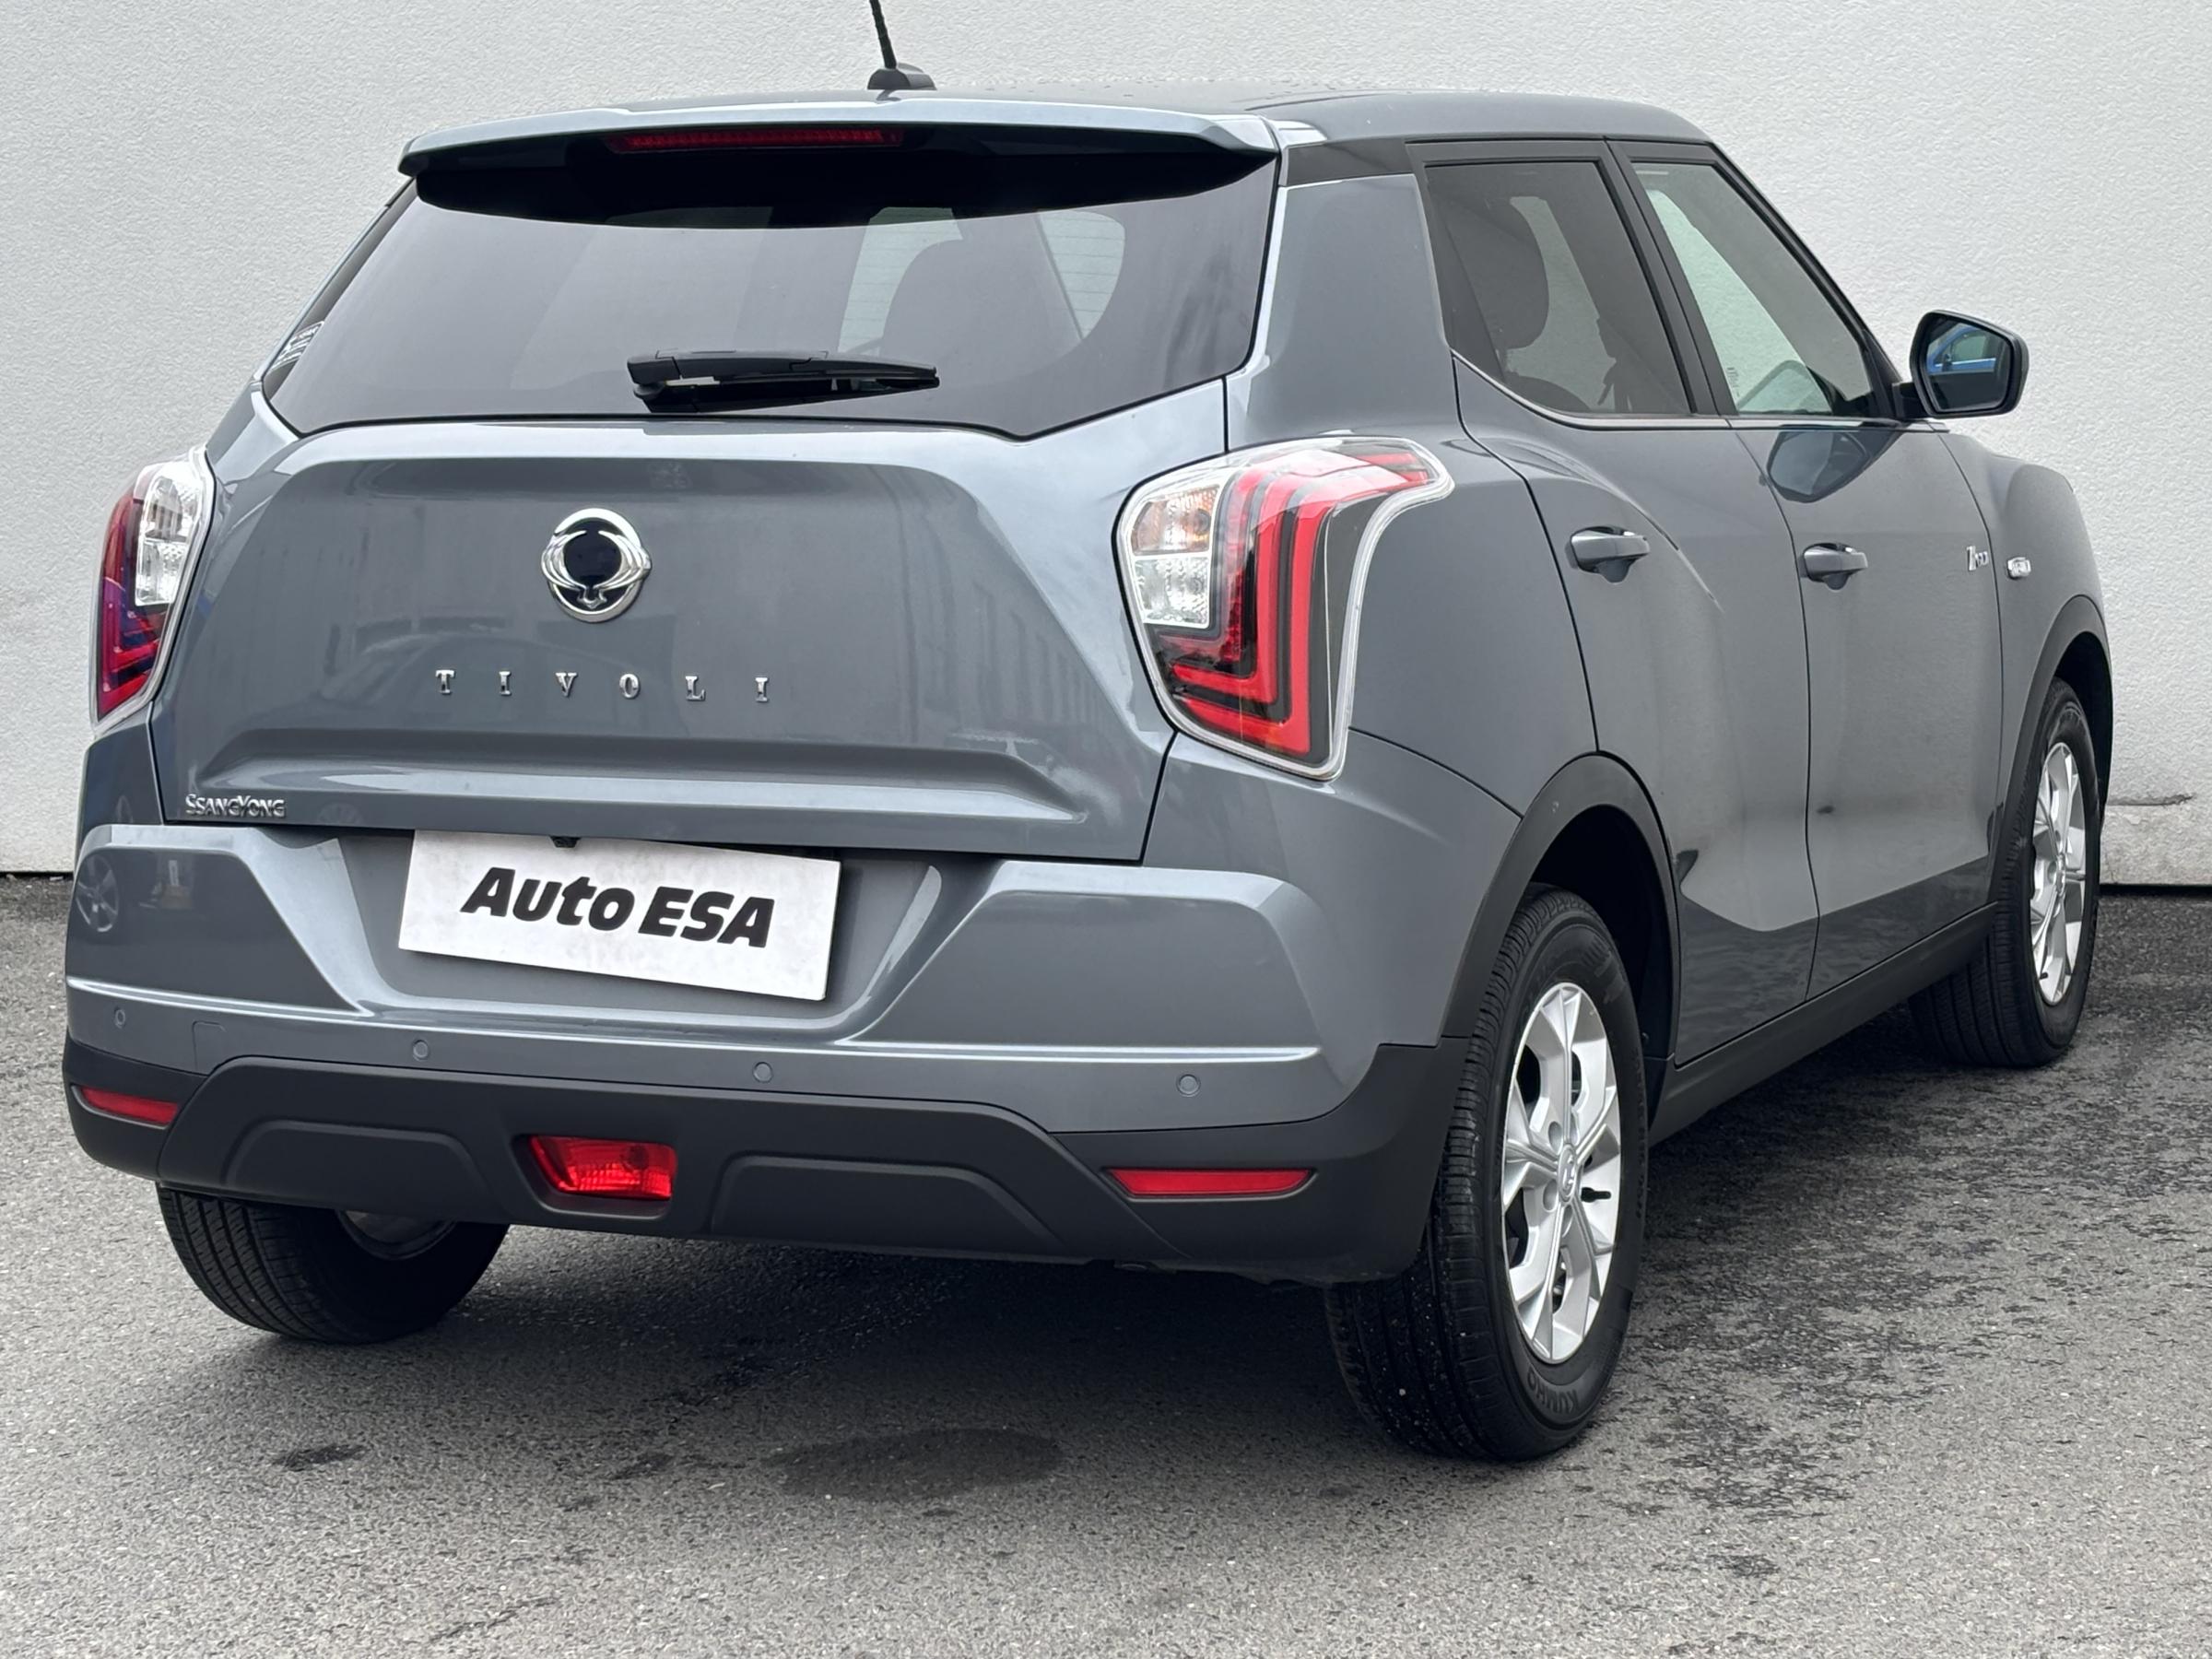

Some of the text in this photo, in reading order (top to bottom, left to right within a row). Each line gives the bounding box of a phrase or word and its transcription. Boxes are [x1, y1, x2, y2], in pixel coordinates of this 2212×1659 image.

[435, 669, 770, 703] TIVOLI
[460, 866, 775, 948] Auto ESA
